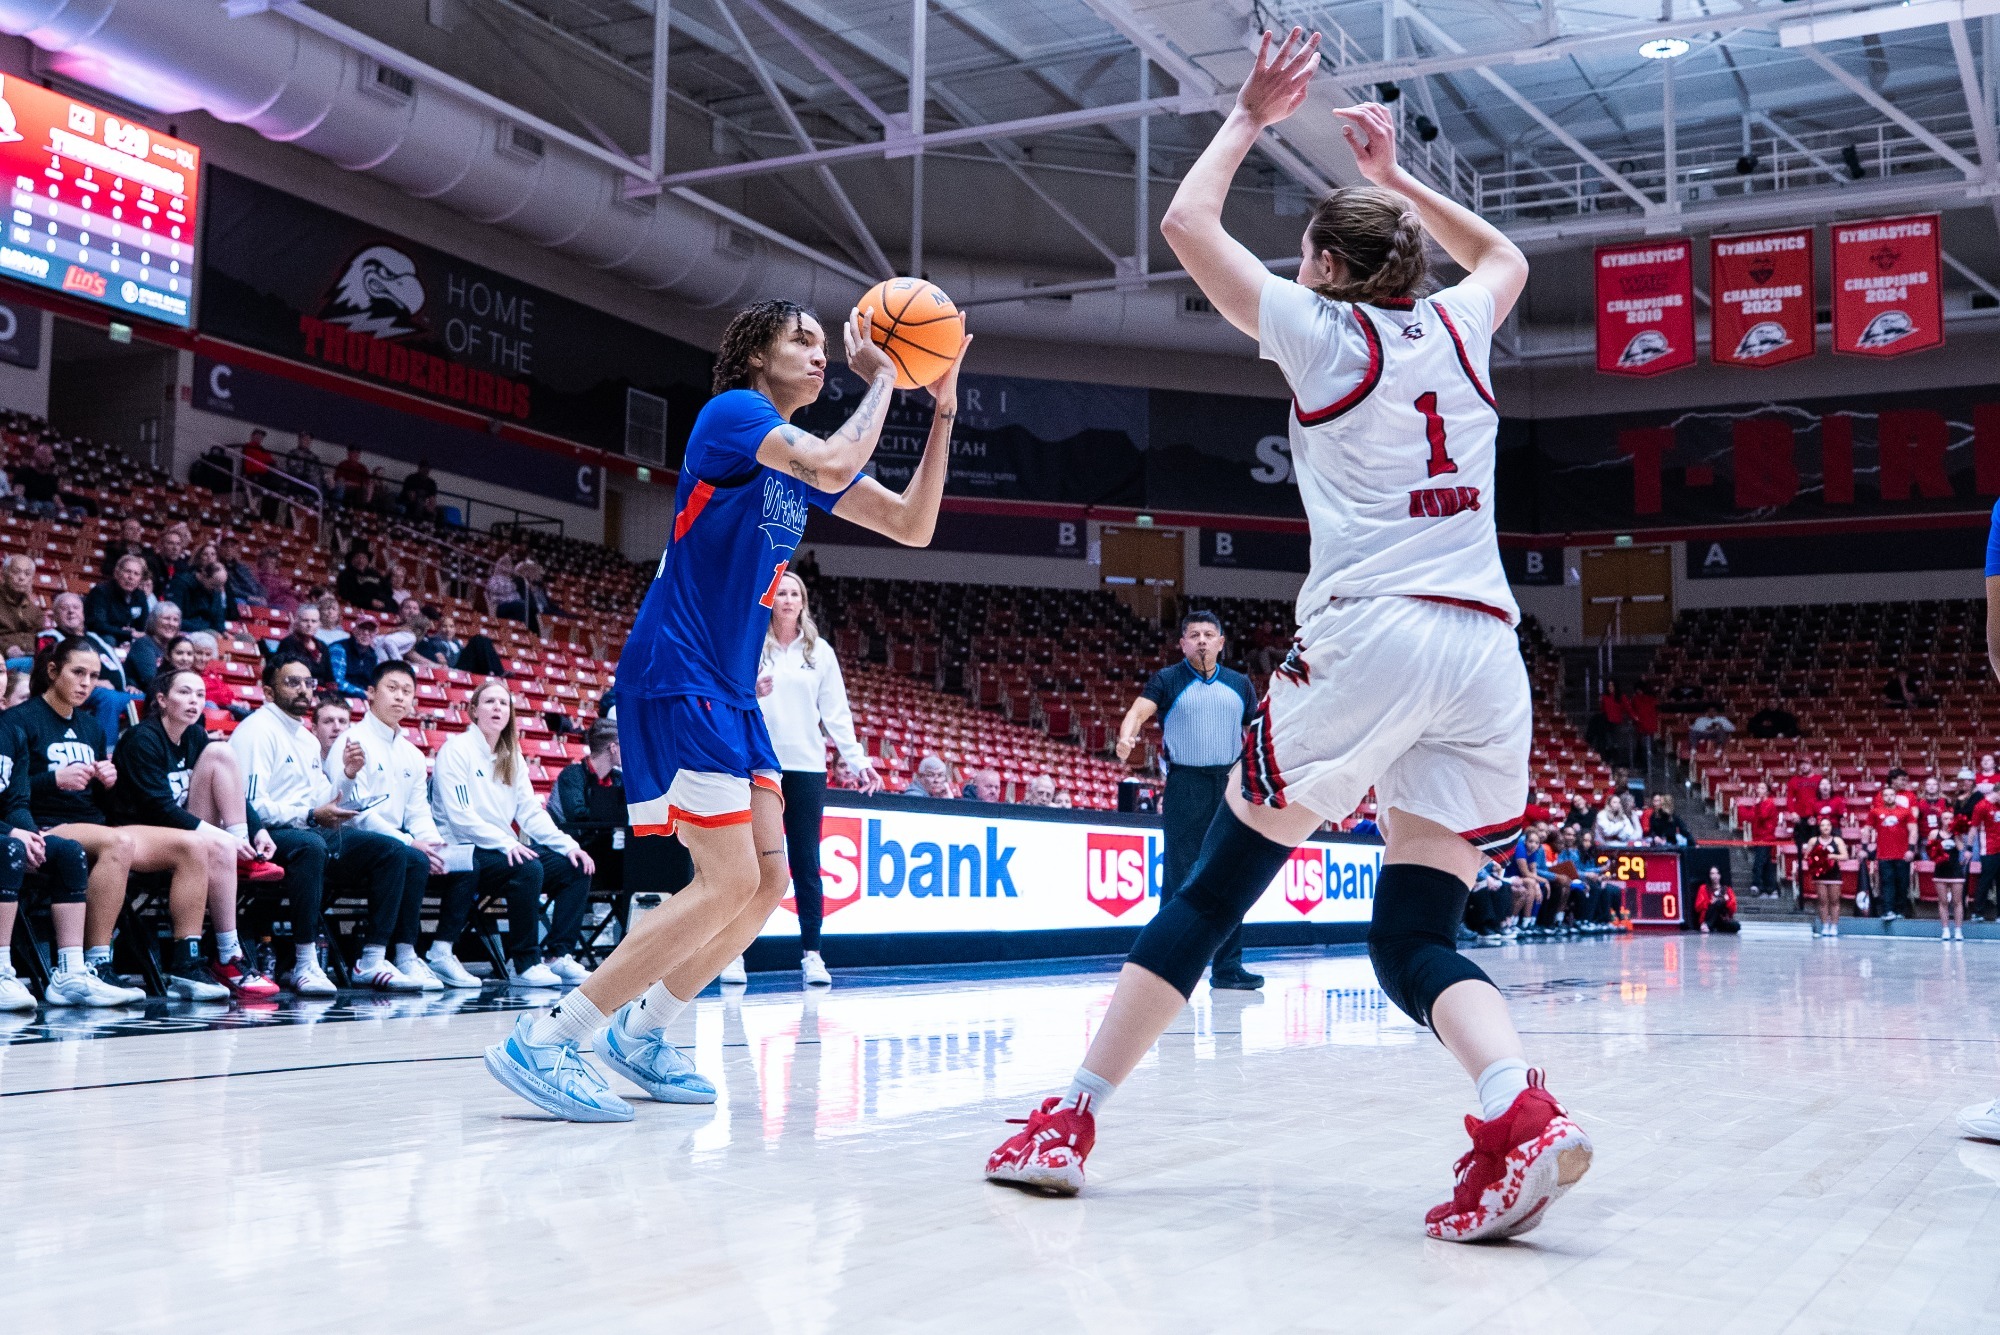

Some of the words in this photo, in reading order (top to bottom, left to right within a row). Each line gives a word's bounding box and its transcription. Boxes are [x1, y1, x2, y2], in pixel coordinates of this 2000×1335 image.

[1839, 223, 1931, 244] GYMNASTICS
[1601, 247, 1685, 268] GYMNASTICS
[1717, 235, 1806, 257] GYMNASTICS
[1844, 271, 1928, 292] CHAMPIONS
[448, 273, 534, 333] HOME
[1606, 294, 1683, 313] CHAMPIONS
[1723, 285, 1803, 304] CHAMPIONS
[1865, 286, 1907, 304] 2024
[1742, 299, 1782, 315] 2023
[445, 318, 481, 354] OF
[487, 330, 533, 374] THE
[300, 315, 530, 419] THUNDERBIRDS
[210, 364, 232, 398] C
[879, 434, 922, 452] CITY
[952, 440, 986, 457] TAH
[1414, 391, 1458, 478] 1
[577, 465, 591, 493] C
[1059, 523, 1076, 545] B
[1216, 533, 1233, 555] B
[1527, 551, 1544, 573] B
[1704, 543, 1728, 566] A
[867, 819, 1018, 898] bank
[1089, 848, 1144, 900] us
[1286, 858, 1323, 901] us
[1663, 894, 1676, 917] 0
